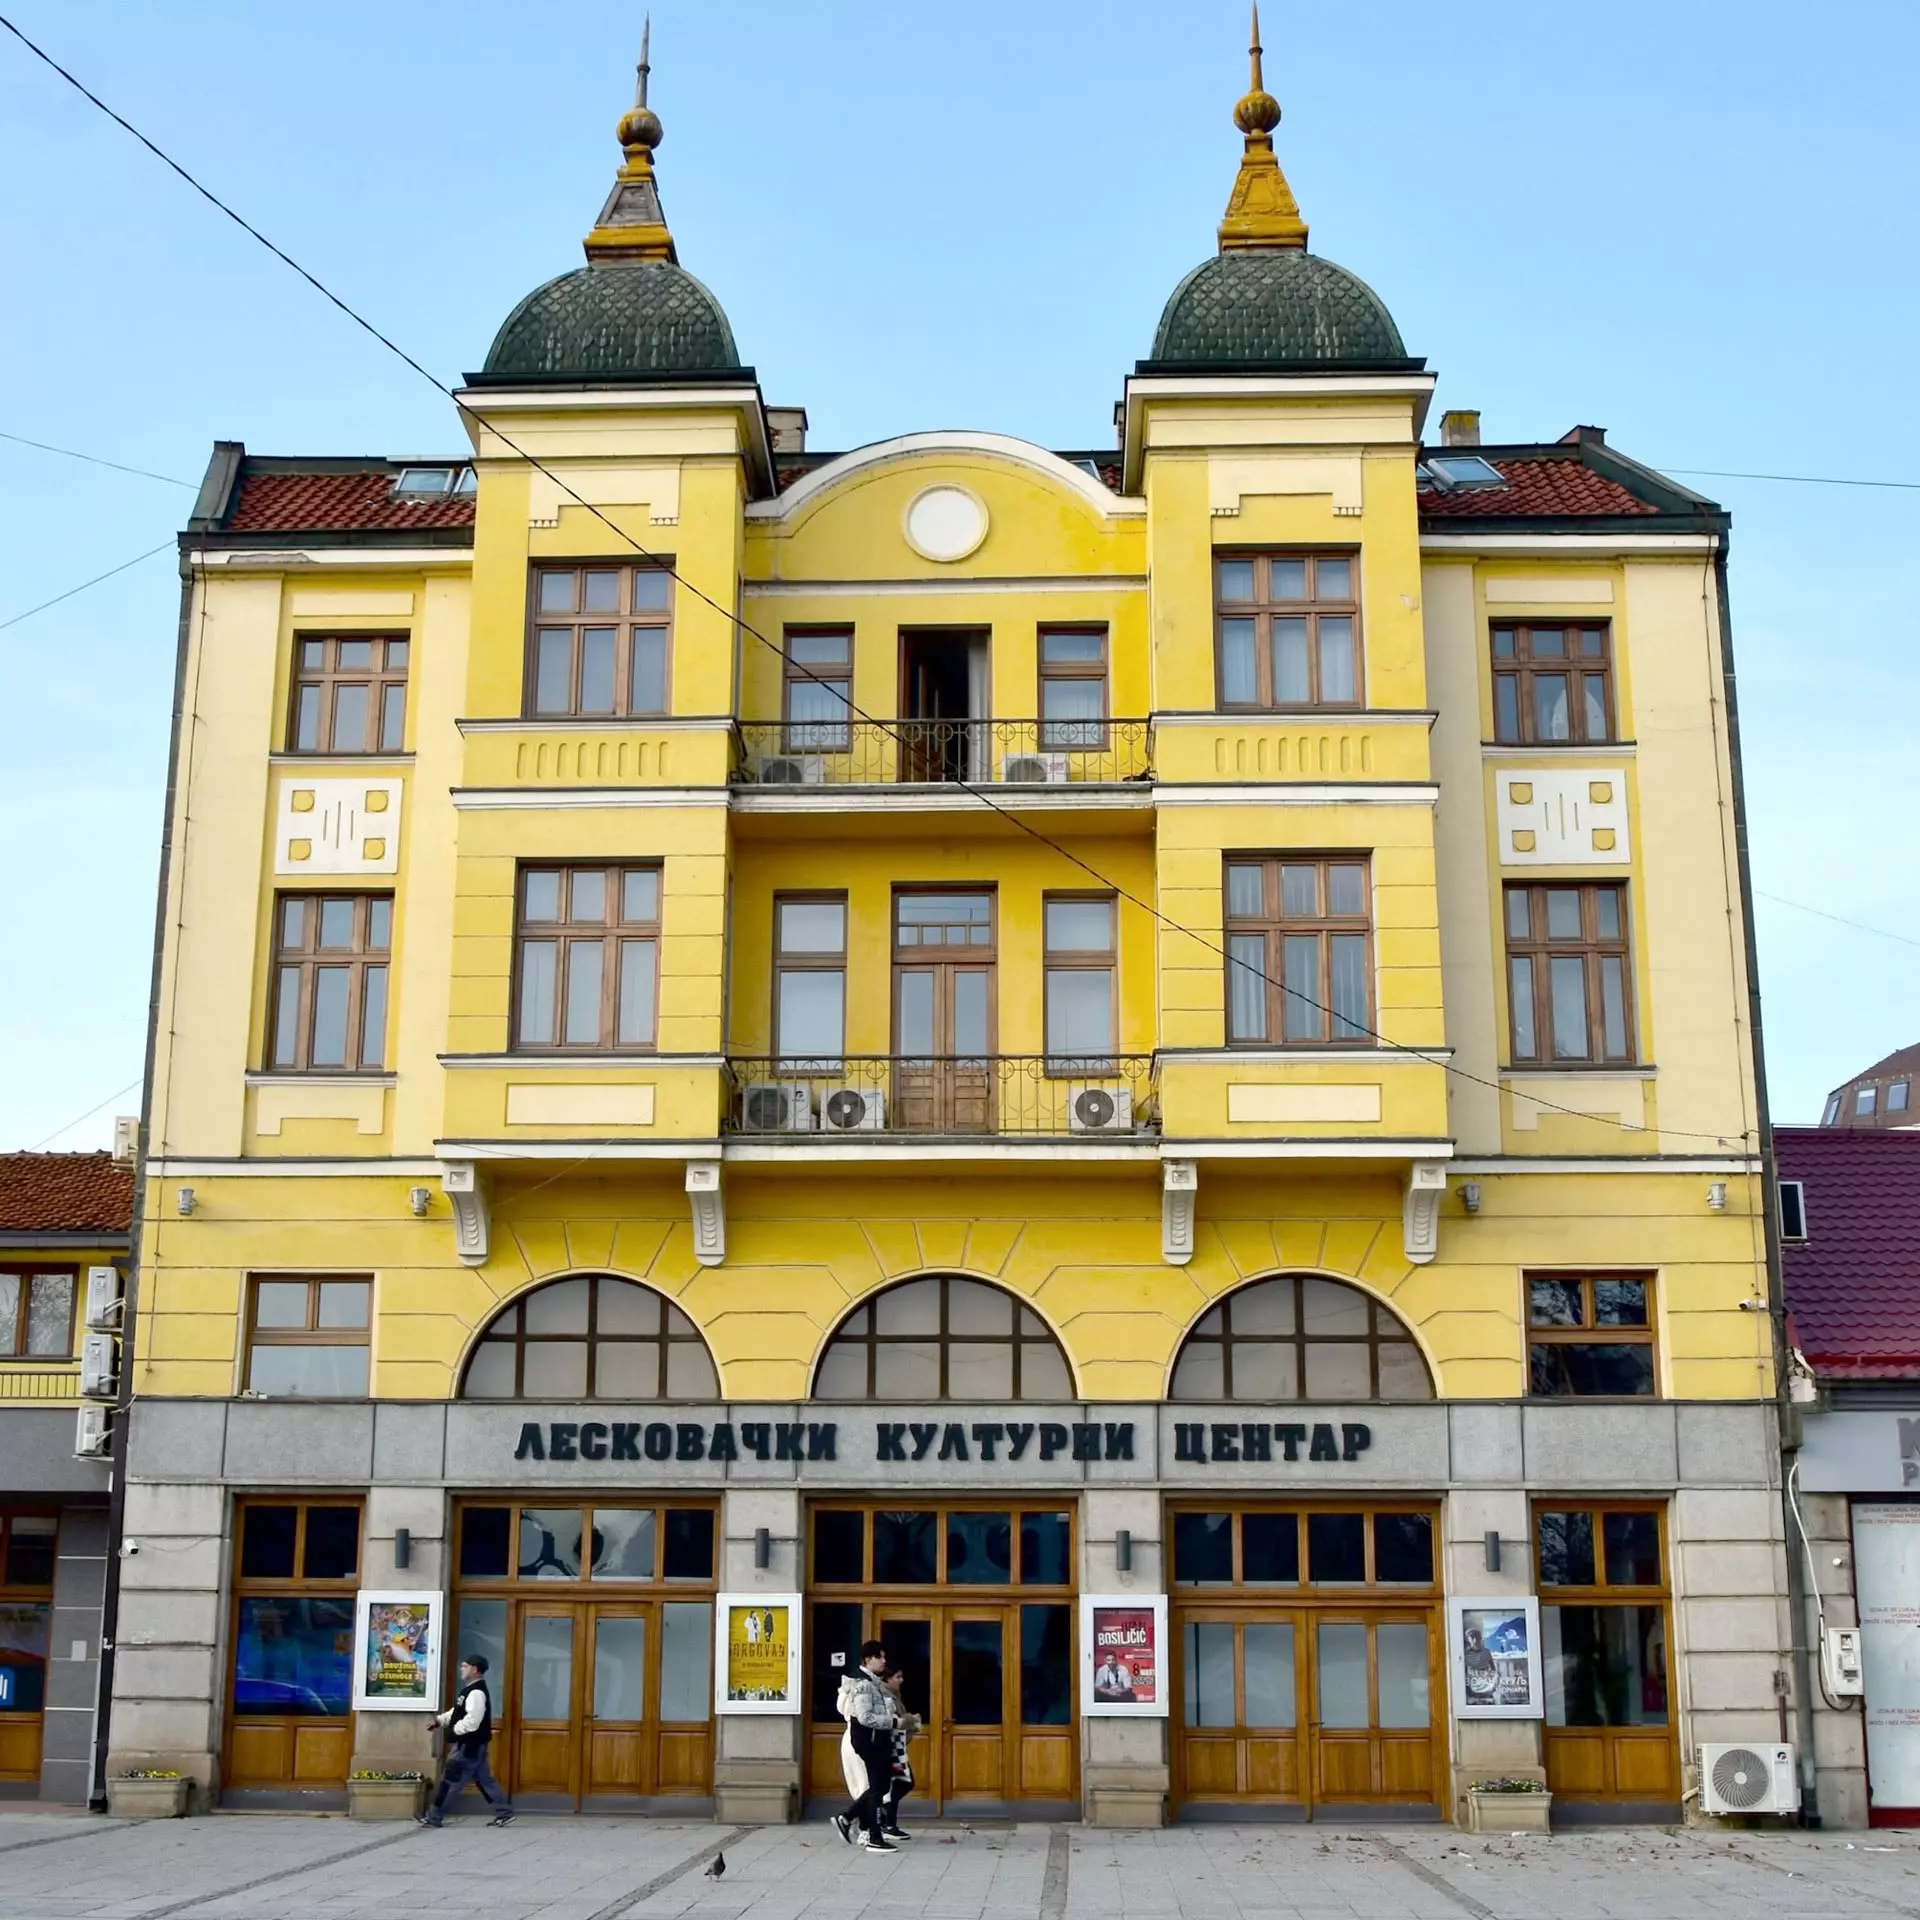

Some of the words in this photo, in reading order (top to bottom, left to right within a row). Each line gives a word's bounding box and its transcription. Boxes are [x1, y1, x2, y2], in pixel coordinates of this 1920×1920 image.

[514, 1422, 838, 1461] ЛЕСКОВАЧКИ
[875, 1422, 1135, 1461] КУЛТУРНИ
[1174, 1422, 1372, 1463] ЦЕНТАР
[1098, 1628, 1146, 1645] BOSILJČIĆ
